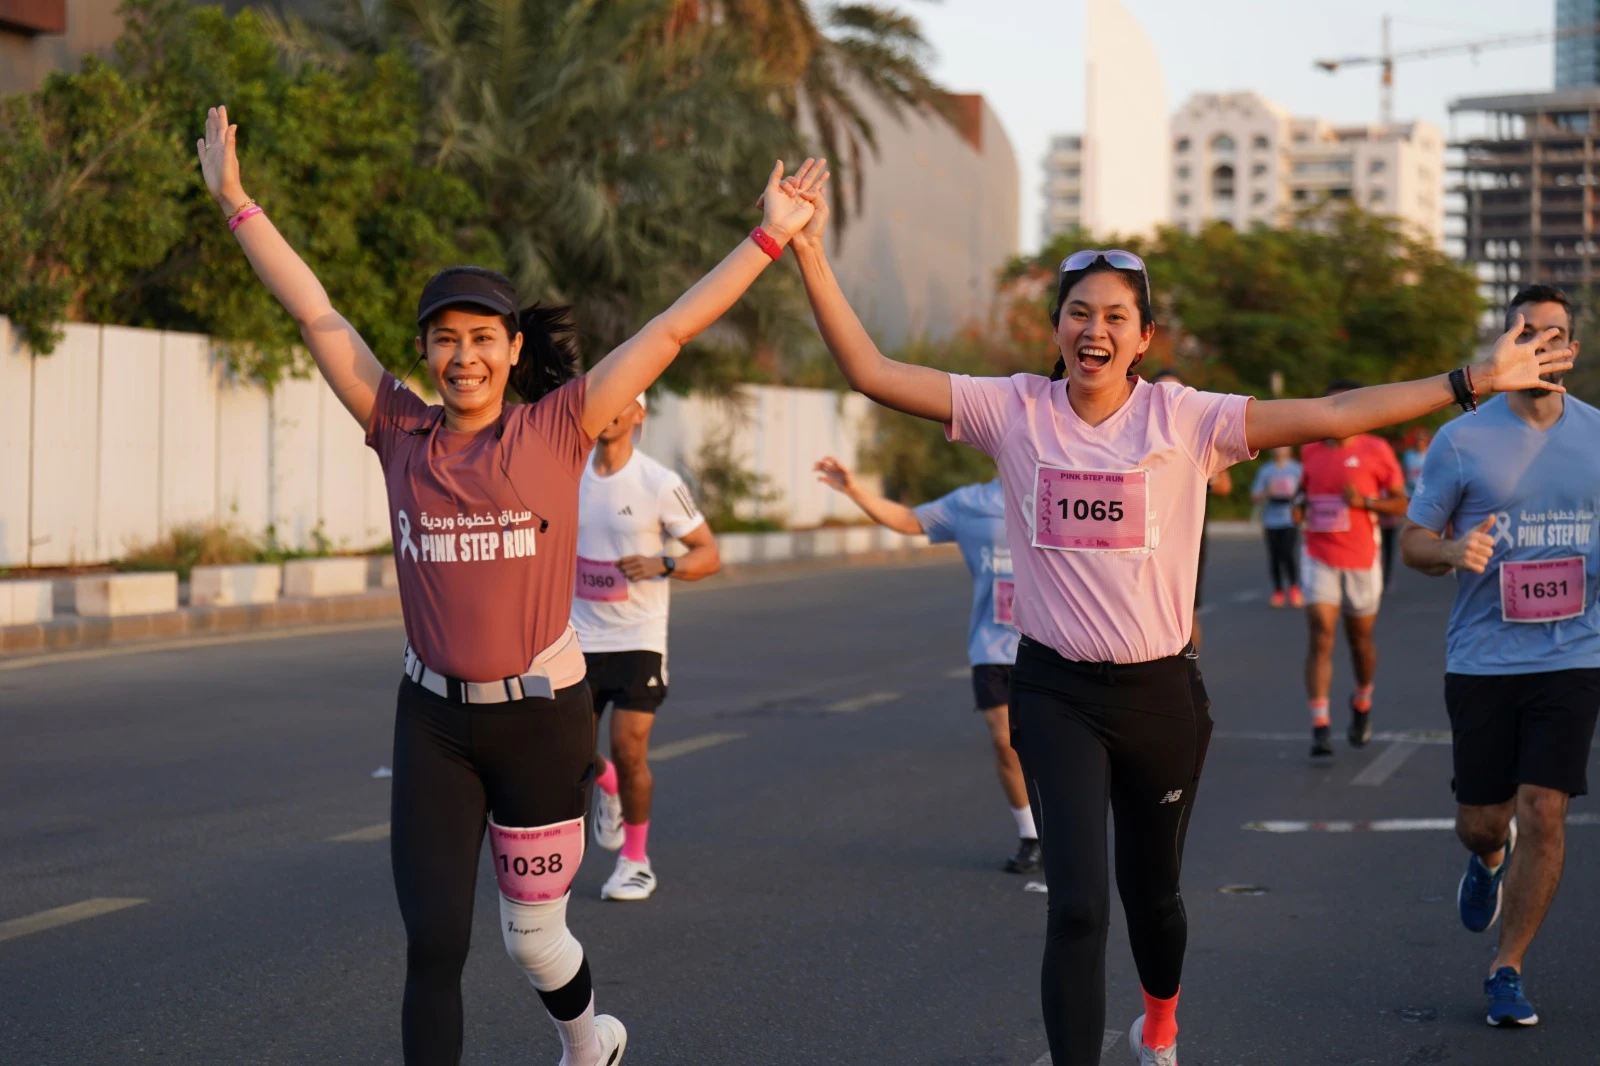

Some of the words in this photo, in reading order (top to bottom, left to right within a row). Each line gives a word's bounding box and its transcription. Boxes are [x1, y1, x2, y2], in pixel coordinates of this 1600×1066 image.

[1060, 472, 1081, 480] PINK
[1082, 473, 1104, 481] STEP
[1105, 475, 1124, 483] RUN
[498, 510, 532, 527] سباق
[1057, 498, 1124, 522] 1065
[420, 512, 455, 531] وردية
[457, 512, 495, 529] خطوة
[1518, 525, 1546, 548] PINK
[1547, 523, 1574, 547] STEP
[420, 533, 458, 563] PINK
[459, 532, 500, 563] STEP
[502, 528, 537, 559] RUN
[581, 573, 615, 589] 1360
[1521, 580, 1568, 599] 1631
[498, 831, 519, 840] PINK
[520, 832, 542, 840] STEP
[543, 829, 562, 838] RUN
[499, 853, 563, 877] 1038
